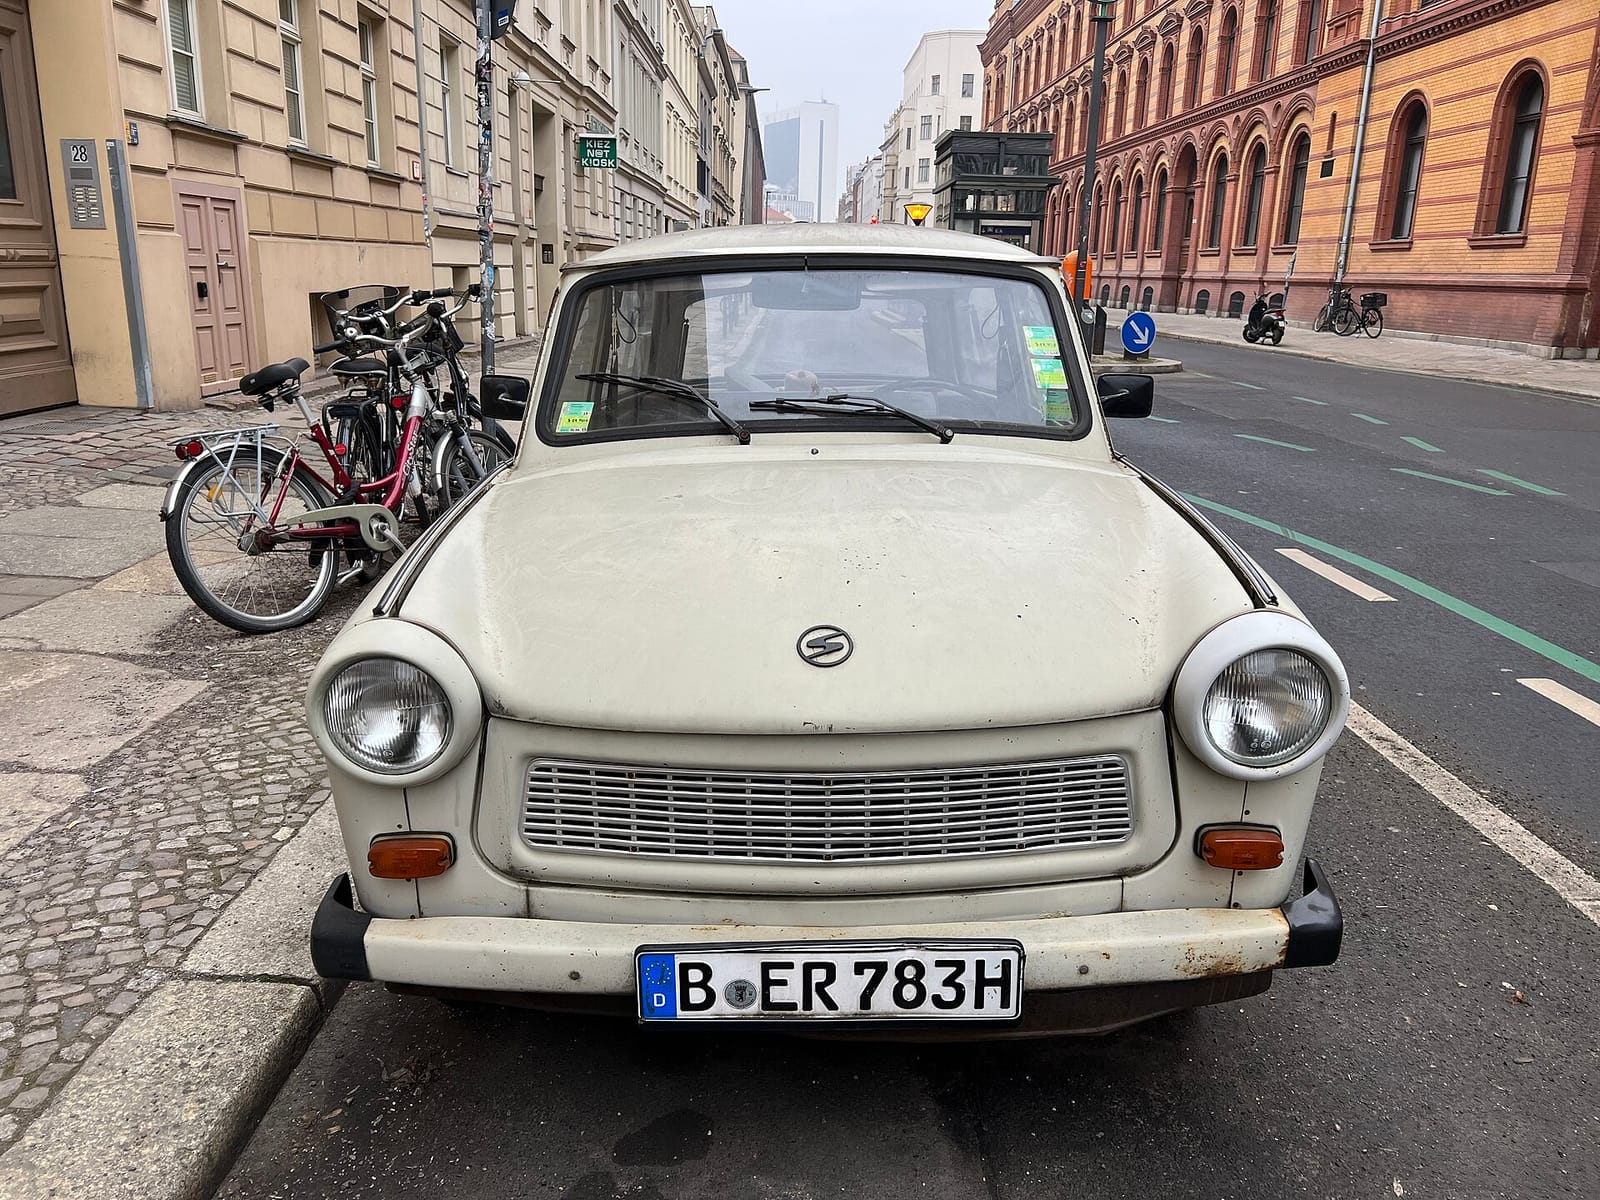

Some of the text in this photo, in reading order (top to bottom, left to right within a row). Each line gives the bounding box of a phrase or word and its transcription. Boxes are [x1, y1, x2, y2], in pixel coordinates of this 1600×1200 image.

[586, 140, 611, 148] KIEZ
[71, 145, 88, 162] 28
[587, 149, 610, 157] N@T
[678, 961, 717, 1012] B
[653, 993, 666, 1007] D
